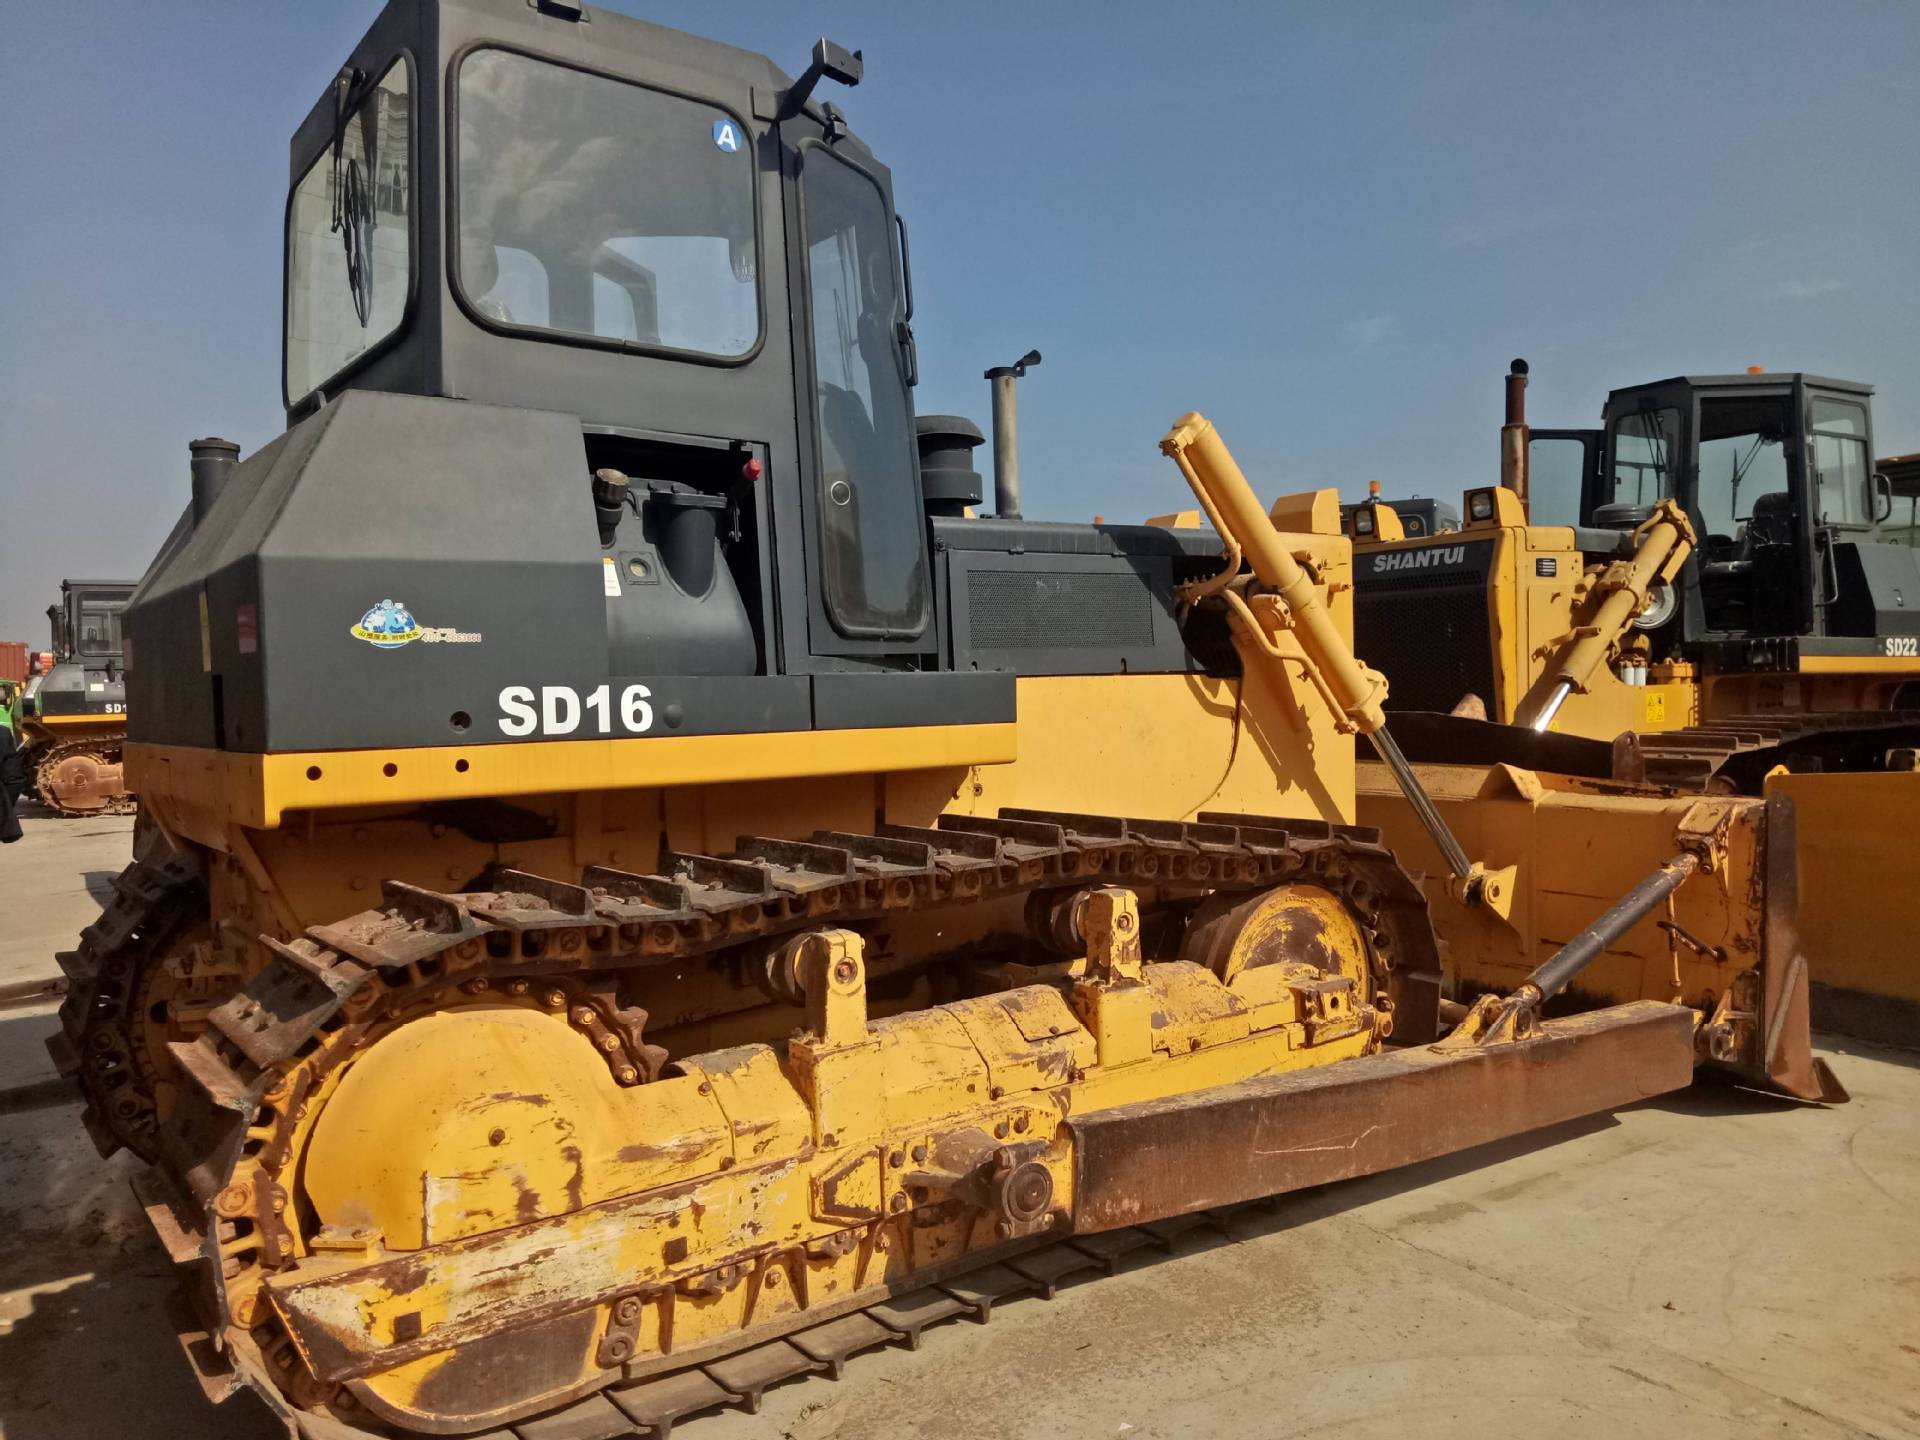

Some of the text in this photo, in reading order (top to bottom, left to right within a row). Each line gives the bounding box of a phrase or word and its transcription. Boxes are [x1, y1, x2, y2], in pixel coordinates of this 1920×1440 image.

[717, 124, 737, 151] A
[1373, 546, 1465, 573] SHANTUI
[1886, 638, 1917, 656] SD22
[498, 684, 653, 736] SD16
